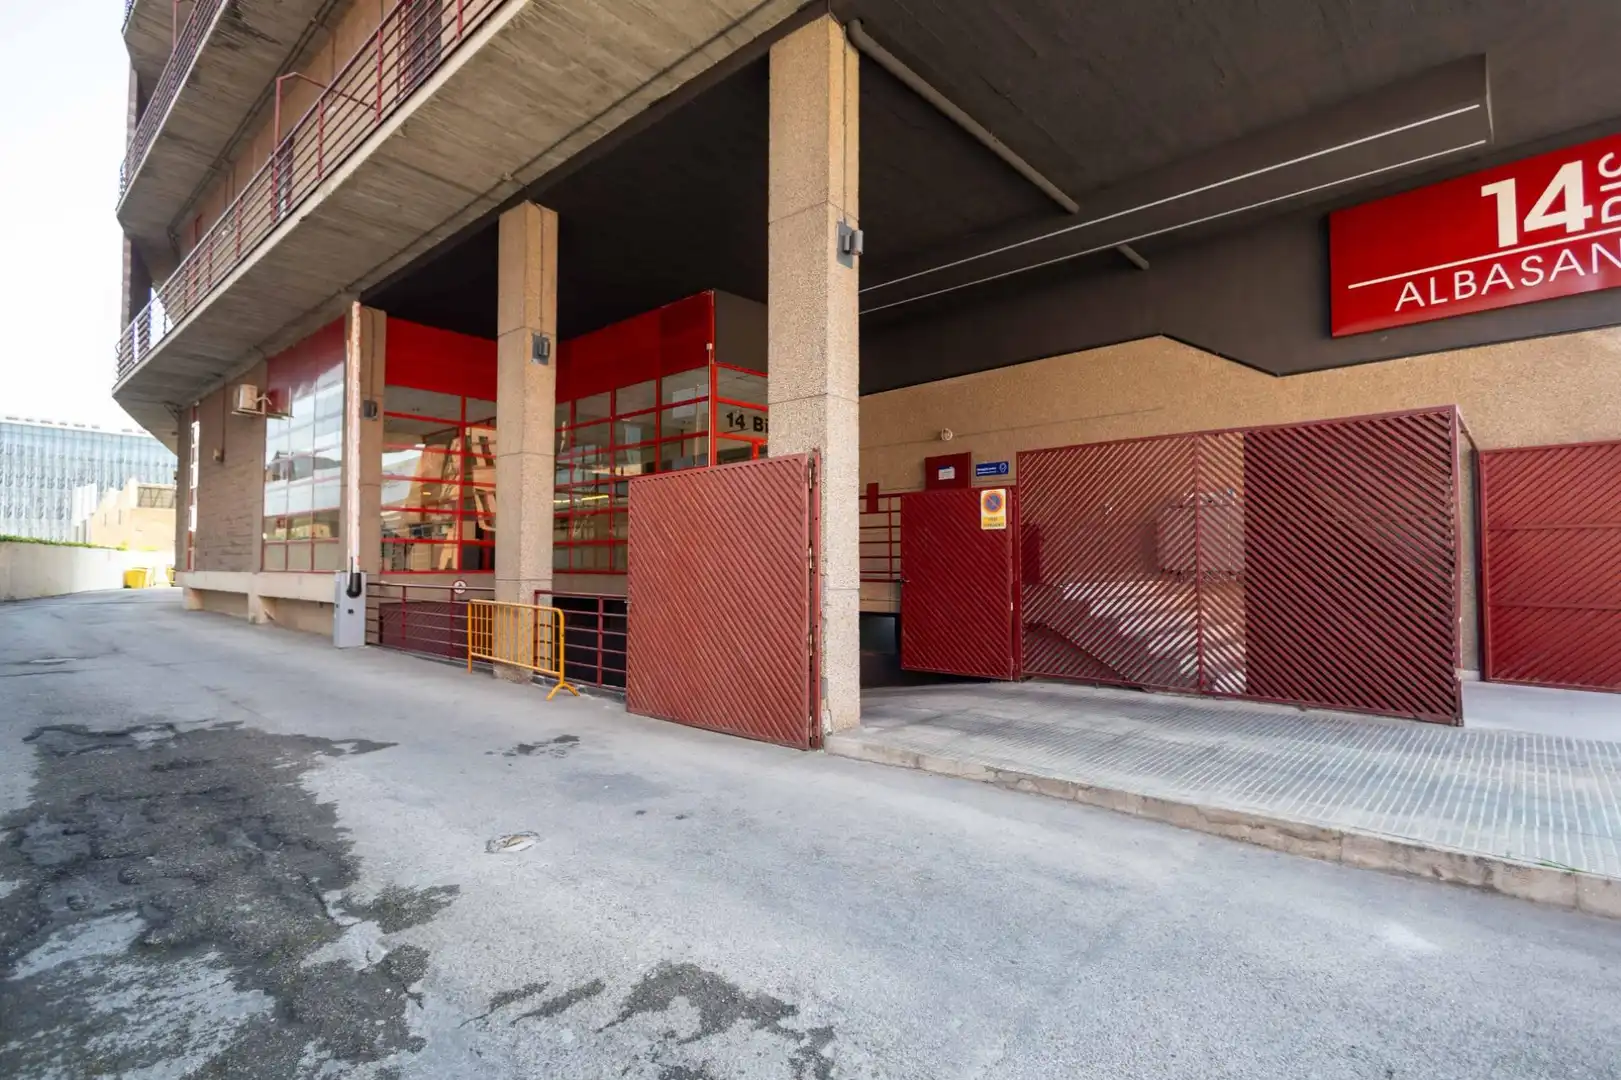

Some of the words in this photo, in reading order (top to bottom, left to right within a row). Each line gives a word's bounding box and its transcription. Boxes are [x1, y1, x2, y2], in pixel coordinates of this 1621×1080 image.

[1481, 160, 1593, 248] 14
[1394, 238, 1621, 312] ALBASAN
[726, 411, 746, 429] 14
